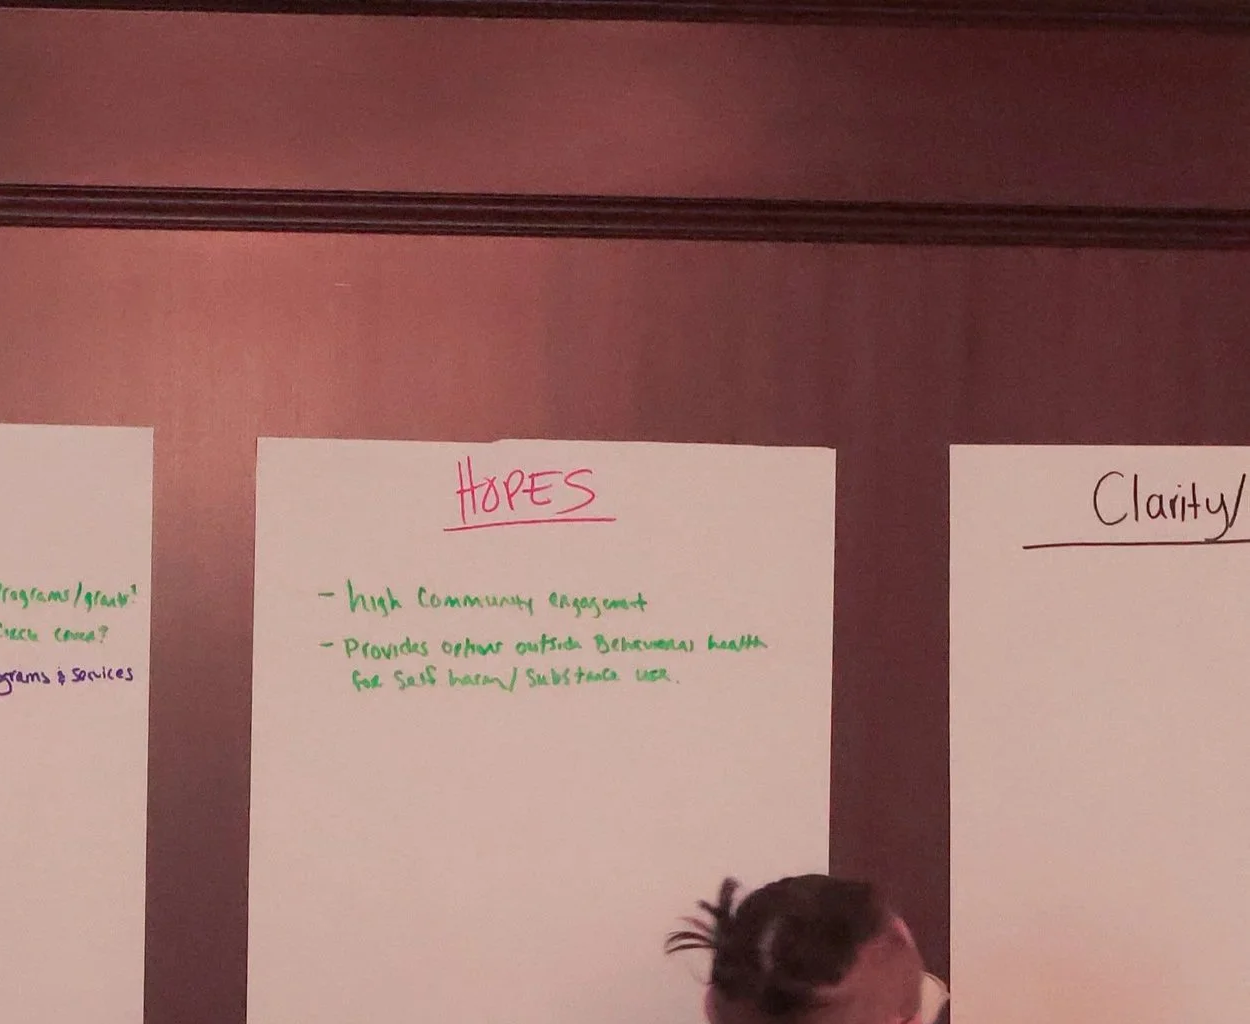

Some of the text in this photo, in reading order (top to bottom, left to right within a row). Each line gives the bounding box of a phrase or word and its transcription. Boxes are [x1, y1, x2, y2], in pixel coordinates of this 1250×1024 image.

[1093, 471, 1247, 542] Clarity/
[707, 634, 768, 652] health
[71, 667, 134, 682] services
